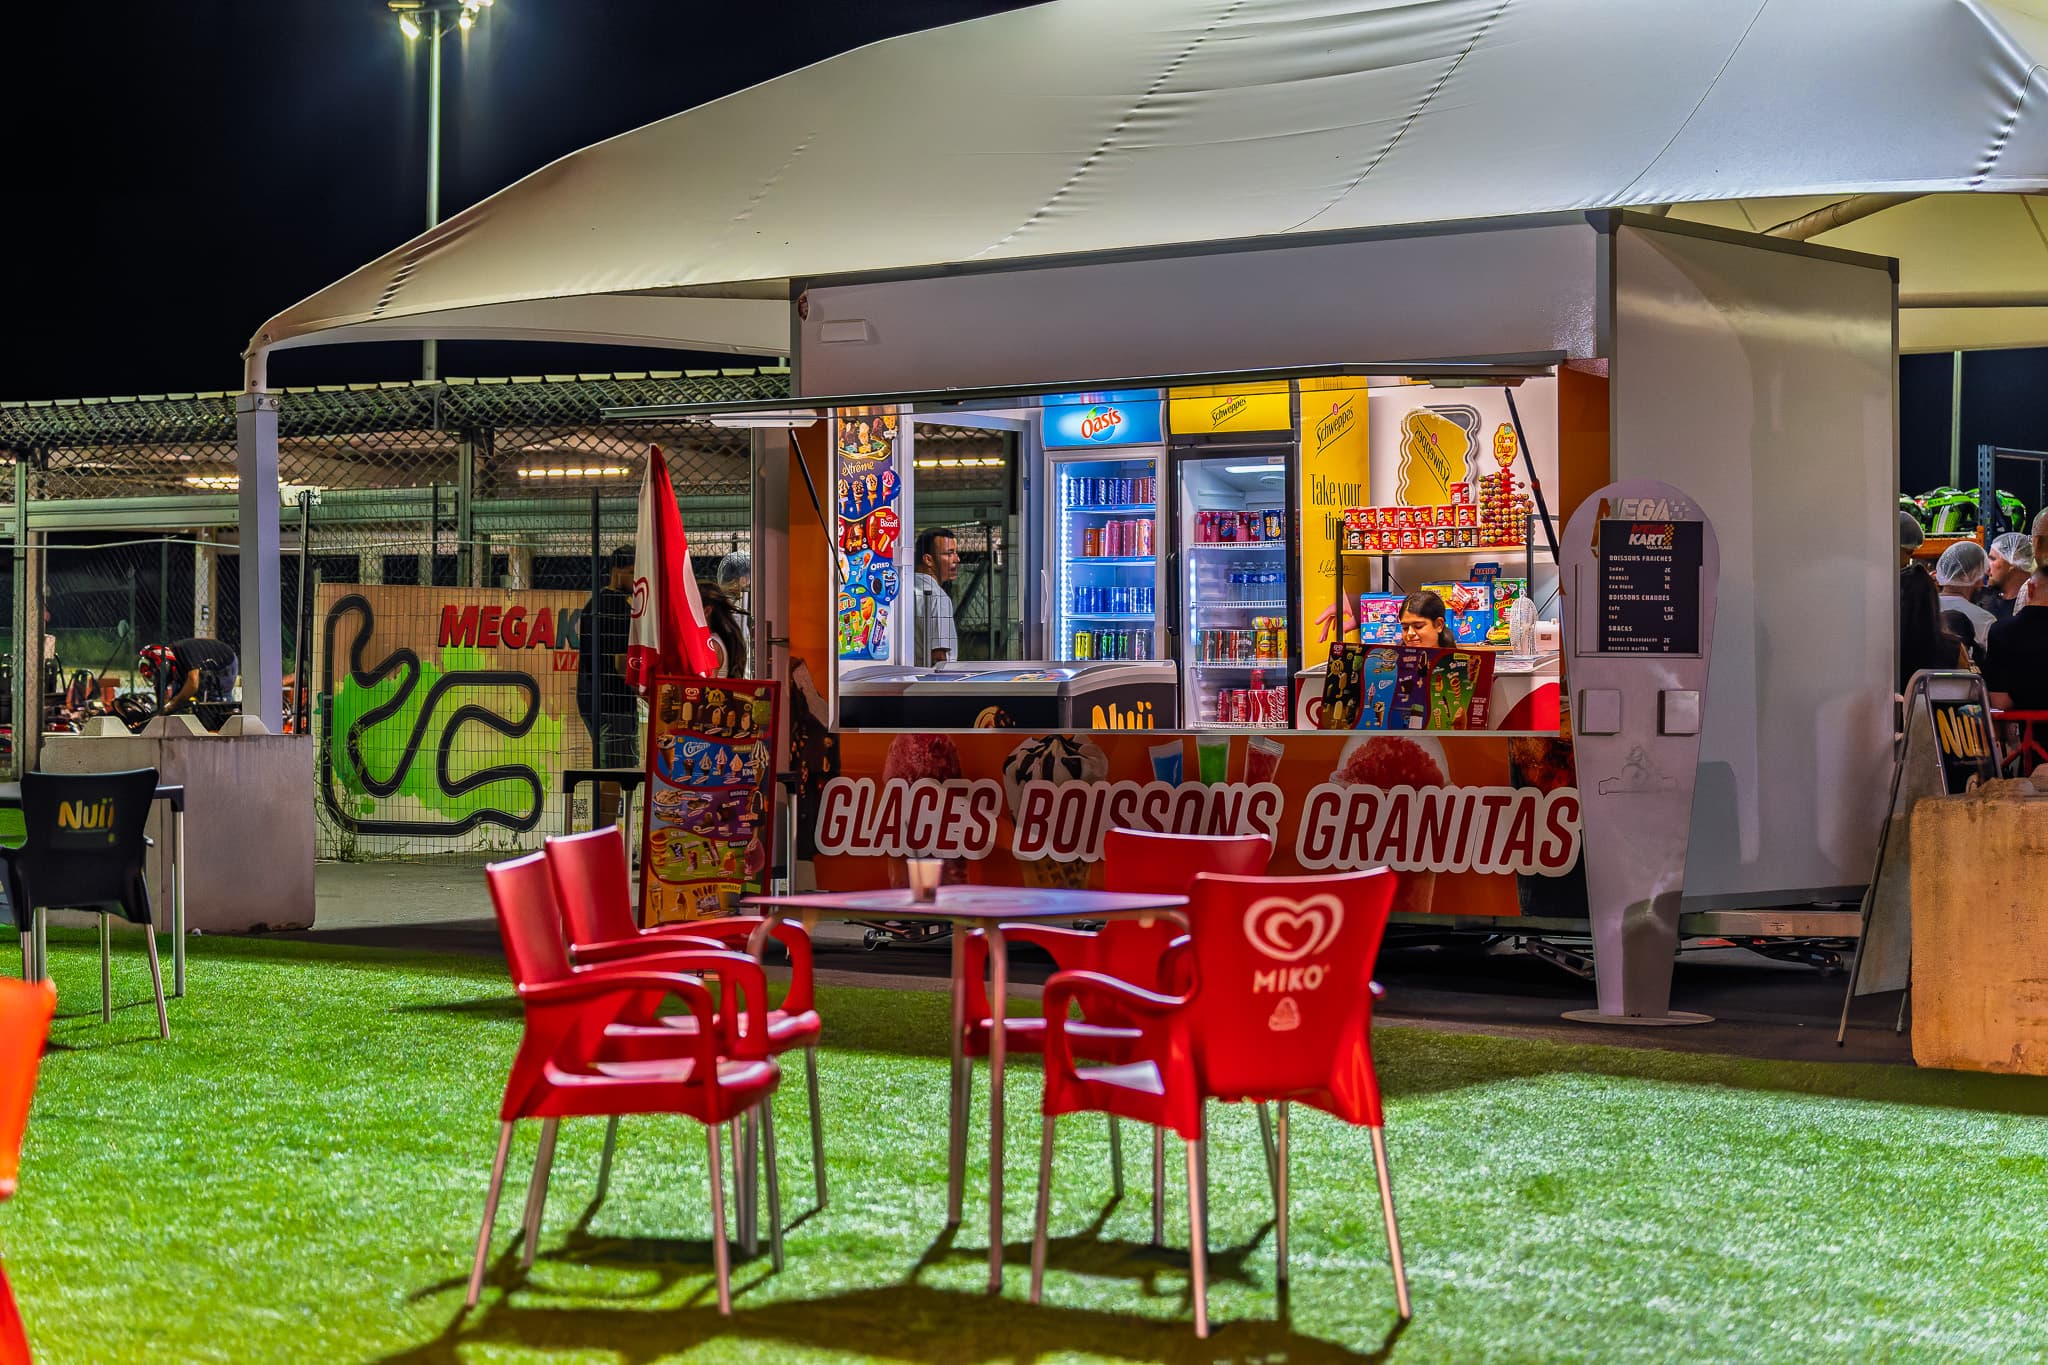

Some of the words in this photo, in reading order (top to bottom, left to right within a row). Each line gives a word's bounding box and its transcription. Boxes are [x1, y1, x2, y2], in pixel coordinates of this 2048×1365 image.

[1081, 407, 1121, 439] Oasis
[1211, 398, 1247, 426] Schweppes
[1317, 406, 1354, 450] Schweppes
[1310, 473, 1336, 506] Take
[1338, 482, 1362, 513] your
[1628, 533, 1666, 546] KART
[57, 798, 115, 830] Nuii
[820, 784, 997, 853] GLACES
[1017, 786, 1278, 856] BOISSONS
[1302, 790, 1581, 869] GRANITAS
[1252, 965, 1325, 994] MIKO
